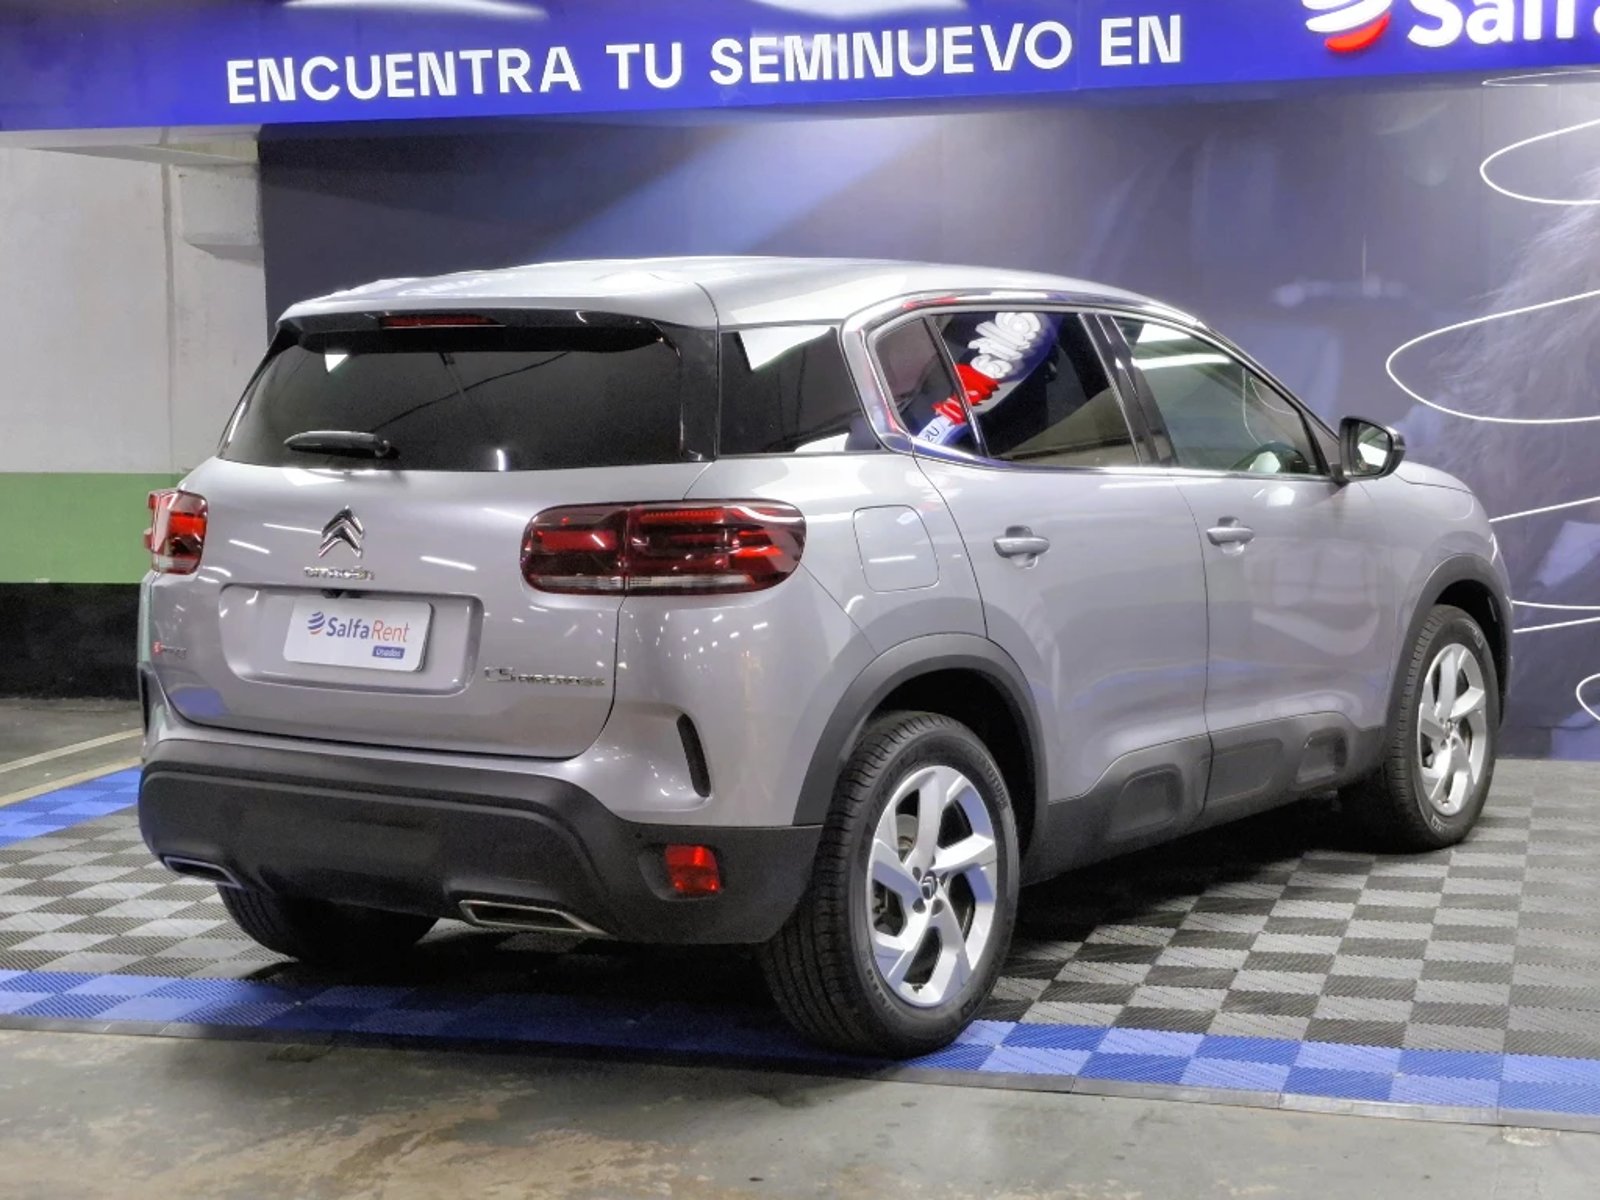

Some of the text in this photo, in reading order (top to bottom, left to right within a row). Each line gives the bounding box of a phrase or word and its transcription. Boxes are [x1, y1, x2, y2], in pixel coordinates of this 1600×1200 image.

[226, 14, 1182, 104] ENCUENTRA TU SEMINUEVO EN
